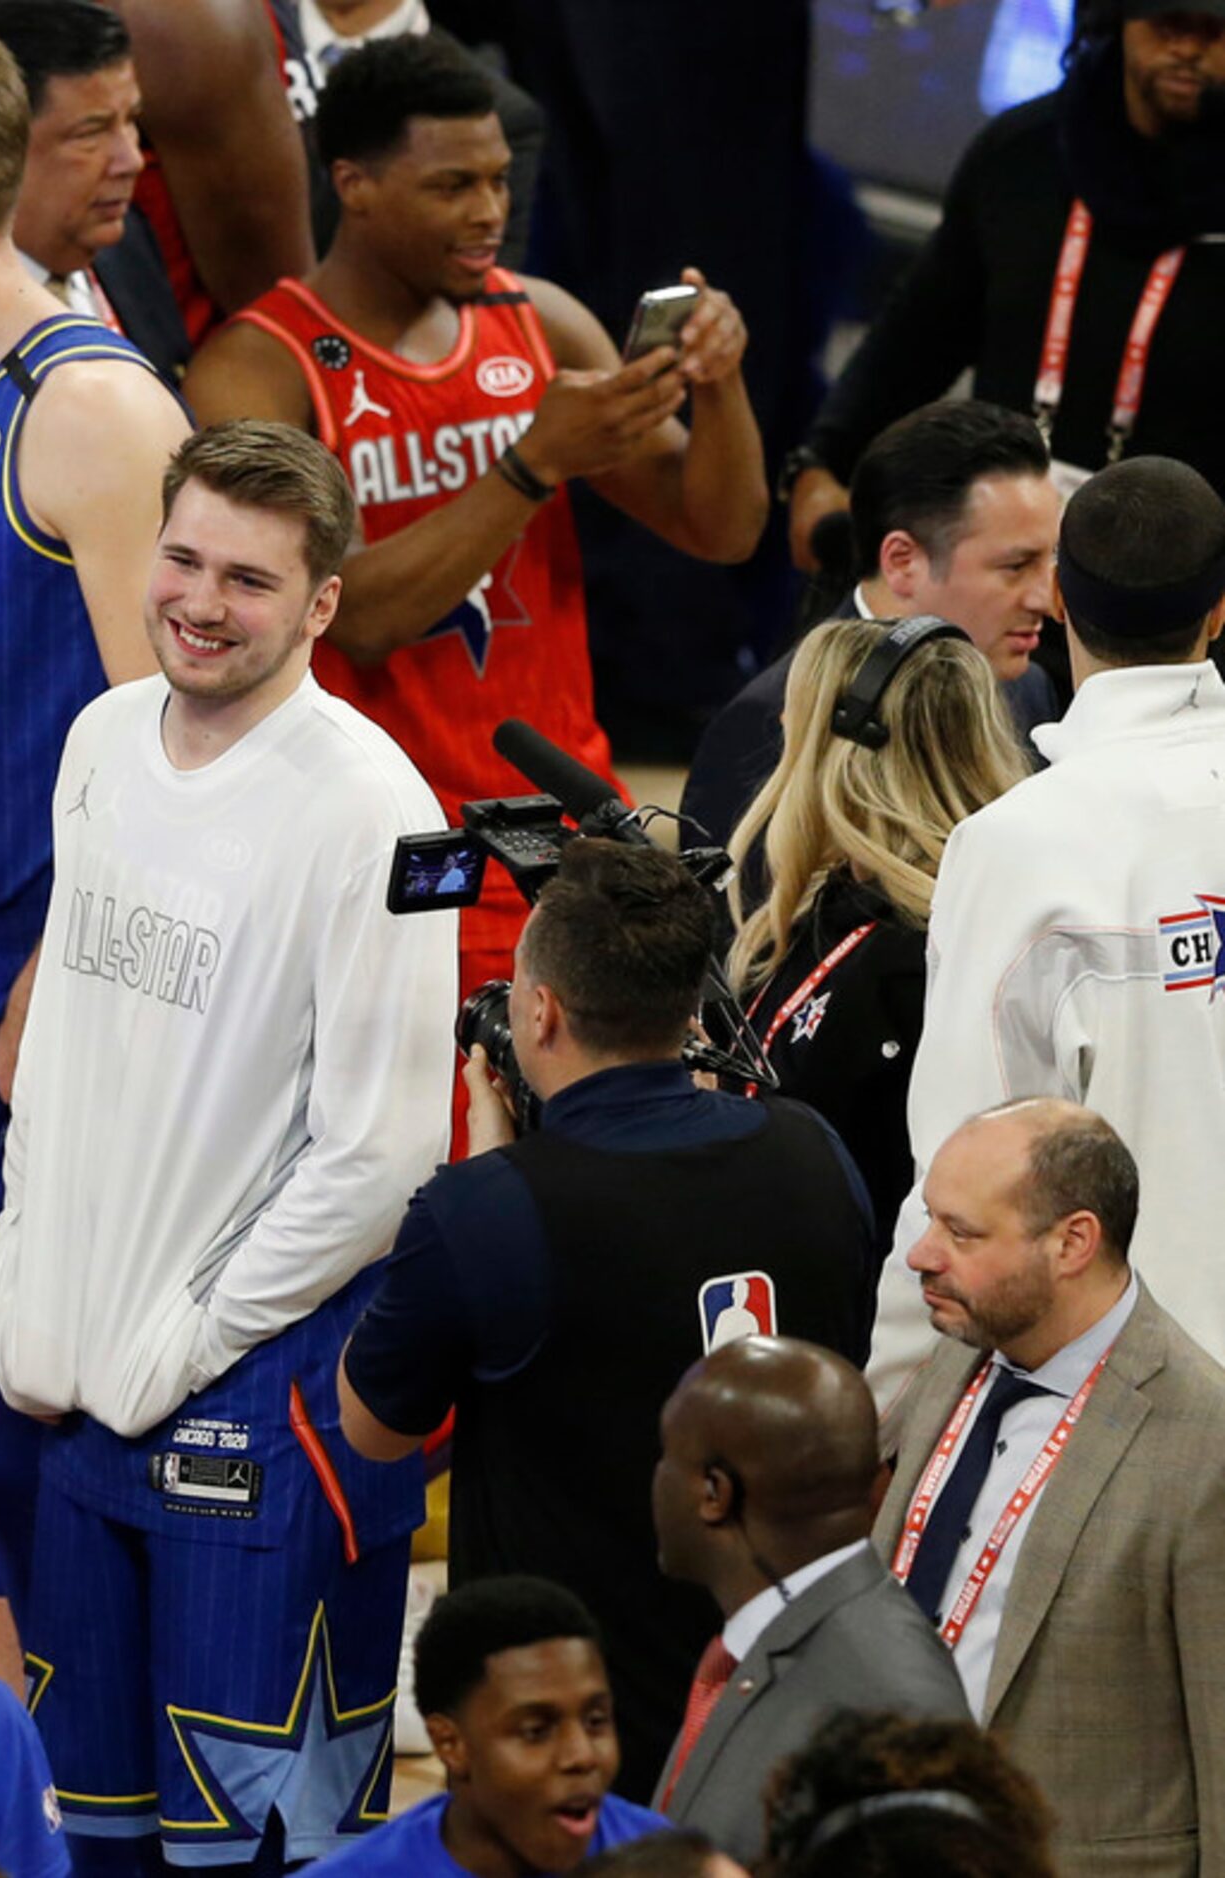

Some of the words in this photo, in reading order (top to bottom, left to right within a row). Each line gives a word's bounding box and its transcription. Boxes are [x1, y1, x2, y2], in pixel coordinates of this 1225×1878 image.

[484, 368, 525, 388] KIA
[350, 411, 535, 506] ALL-STA
[1171, 932, 1214, 967] CH
